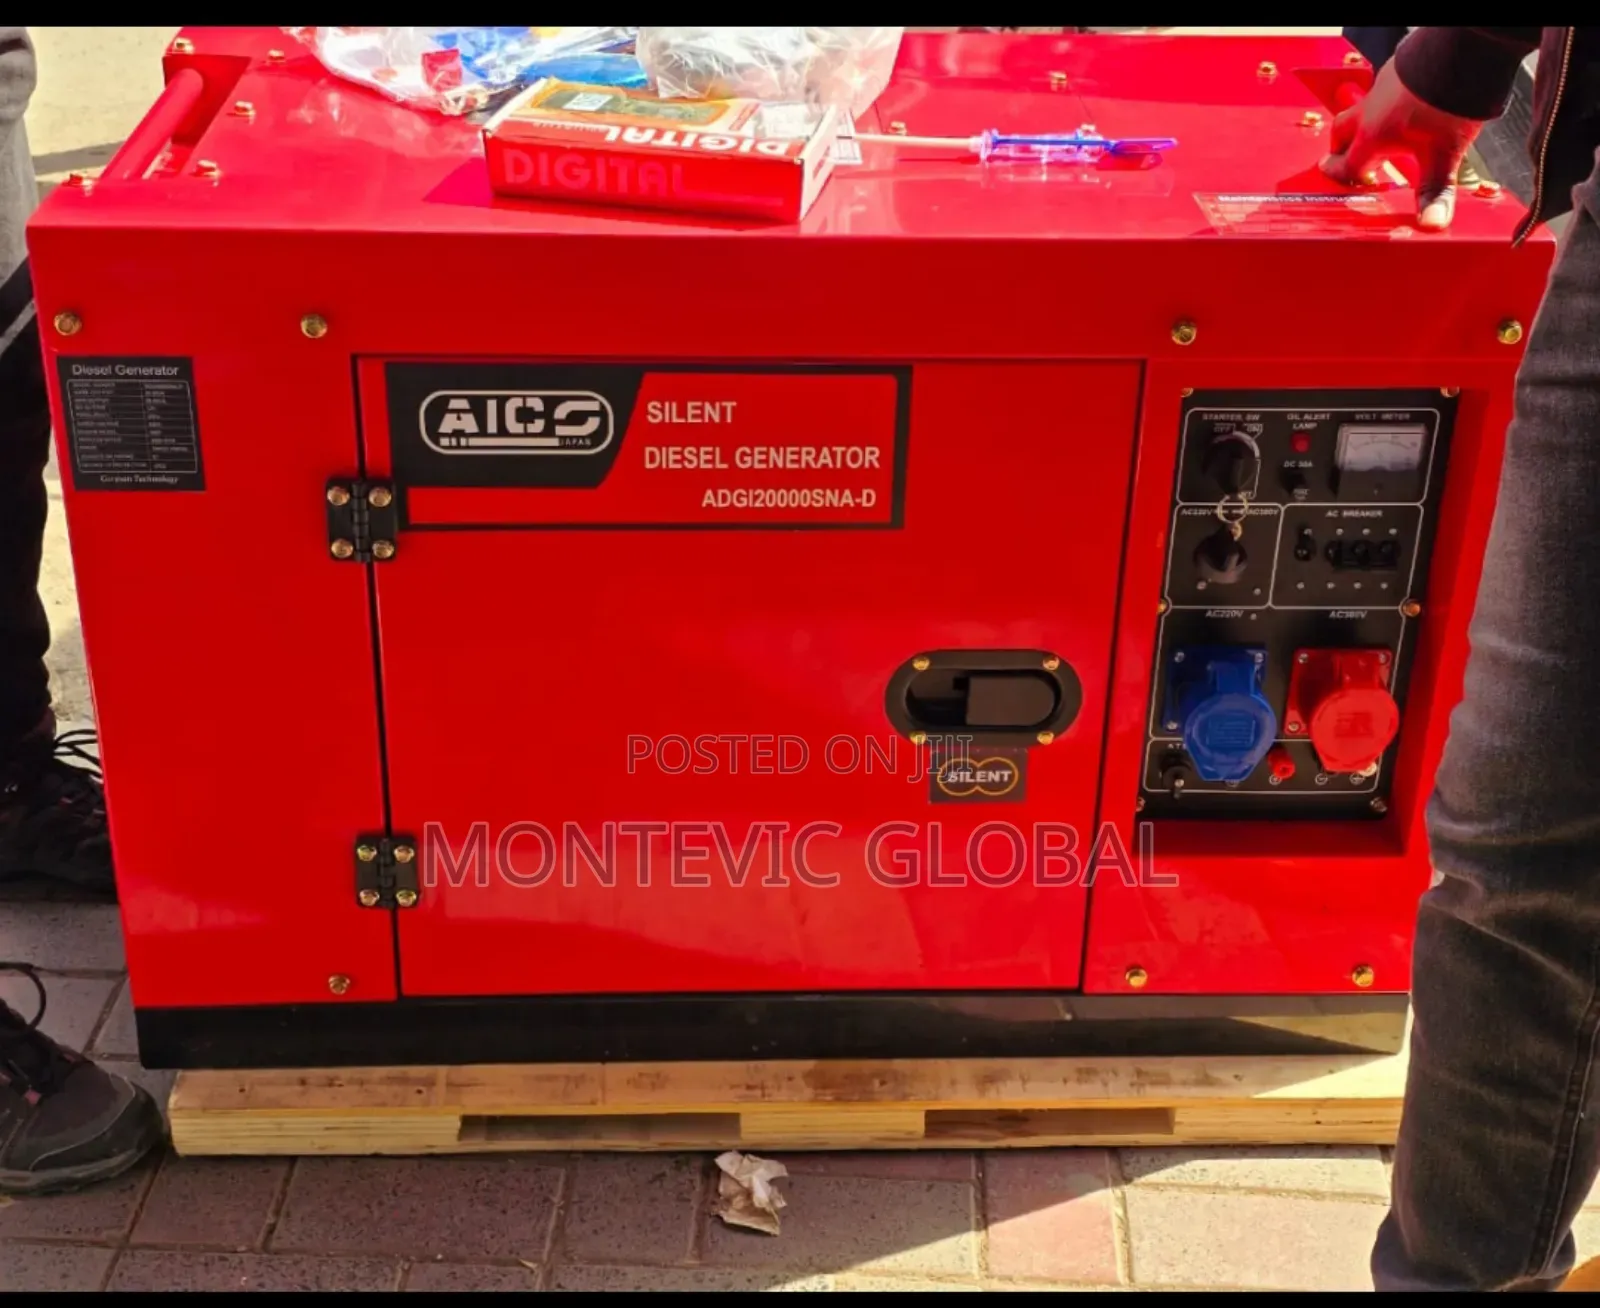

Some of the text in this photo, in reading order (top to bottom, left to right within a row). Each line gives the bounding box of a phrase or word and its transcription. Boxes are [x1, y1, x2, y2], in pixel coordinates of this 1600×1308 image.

[604, 125, 790, 156] DIGITAL
[502, 149, 688, 196] DIGITAL
[72, 364, 179, 376] Diesel Generator
[647, 402, 737, 423] SILENT
[1292, 422, 1318, 430] LAMP
[644, 446, 880, 470] DIESEL GENERATOR
[702, 488, 877, 508] ADGI20000SNA-D
[1325, 509, 1383, 518] AC BREAKER
[947, 770, 1012, 783] SILENT
